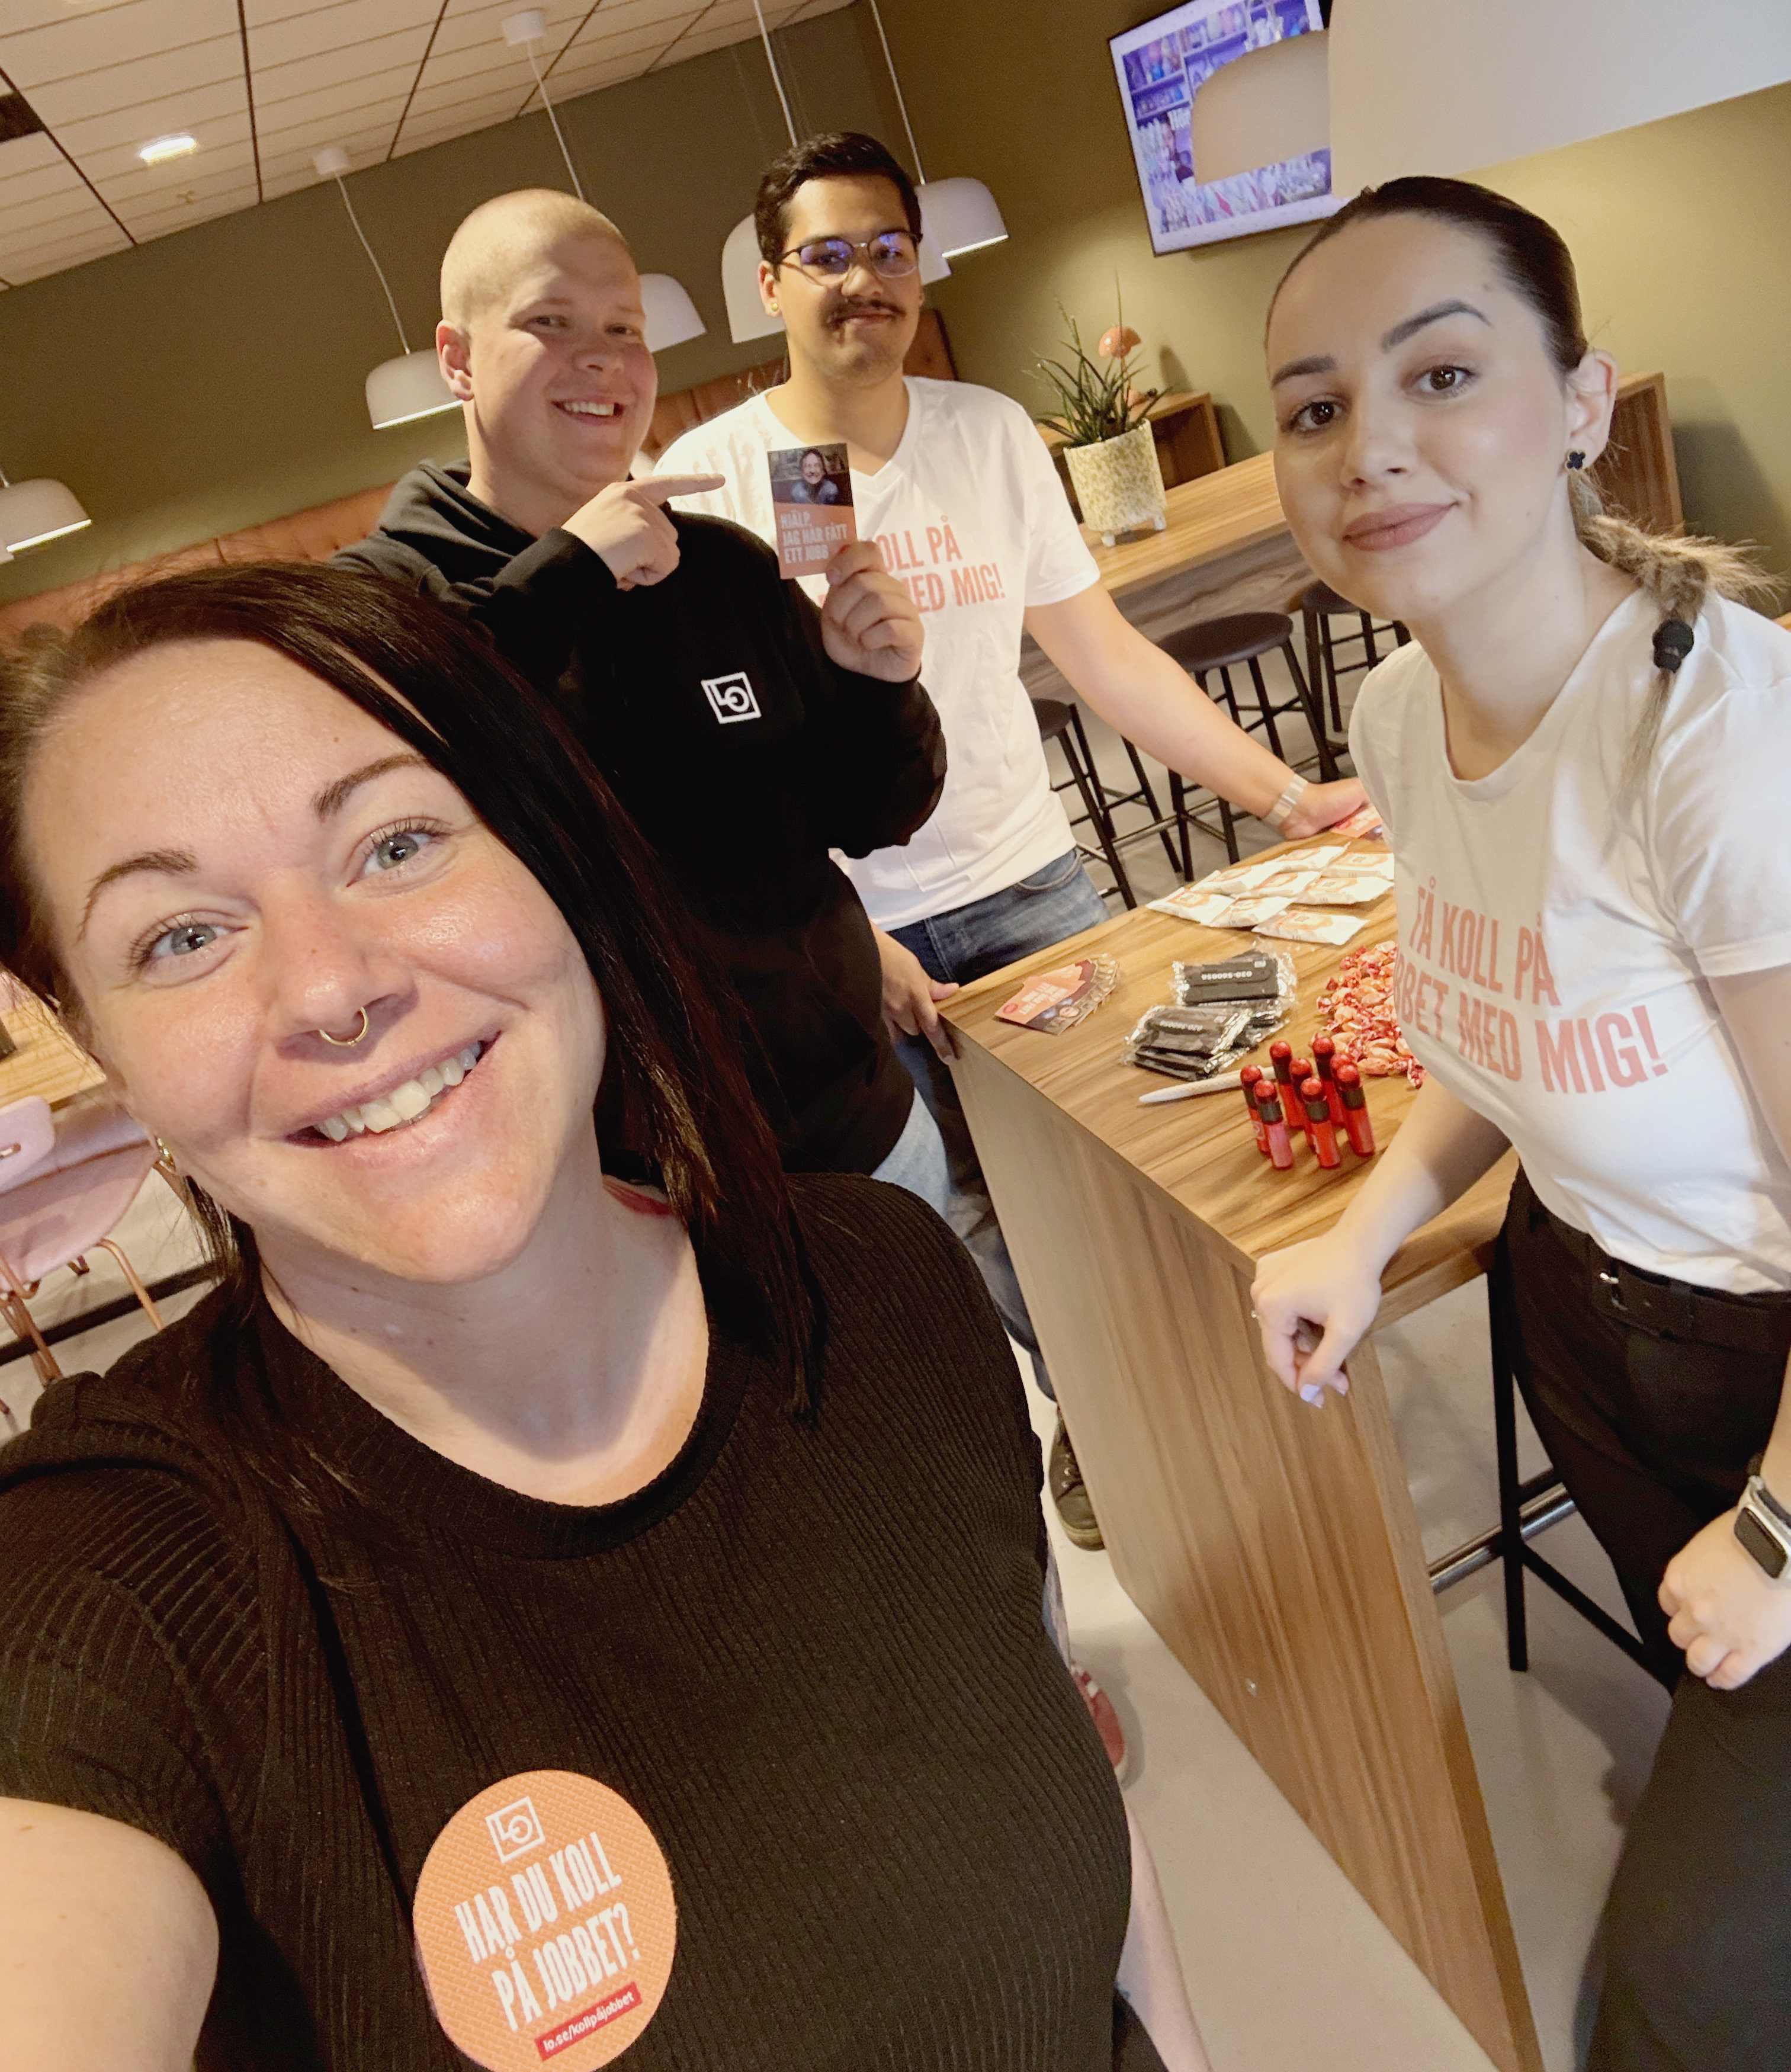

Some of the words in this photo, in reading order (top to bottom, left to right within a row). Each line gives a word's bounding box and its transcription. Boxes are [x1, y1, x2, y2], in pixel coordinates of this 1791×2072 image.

[784, 546, 803, 564] ETT
[875, 530, 925, 573] OLL
[925, 515, 963, 564] PÅ
[950, 562, 1006, 607] MIG!
[1439, 901, 1503, 994] KOLL
[1514, 910, 1562, 1007] PÅ
[1458, 990, 1523, 1082] MED
[1535, 1004, 1668, 1094] MIG!
[454, 1885, 523, 1964] HAR
[510, 1862, 559, 1932] DU
[548, 1831, 623, 1912] KOLL
[491, 1946, 543, 2032] PÅ
[532, 1902, 641, 2011] JOBBET?
[543, 1991, 634, 2052] lo.se/kollpåjobbet
